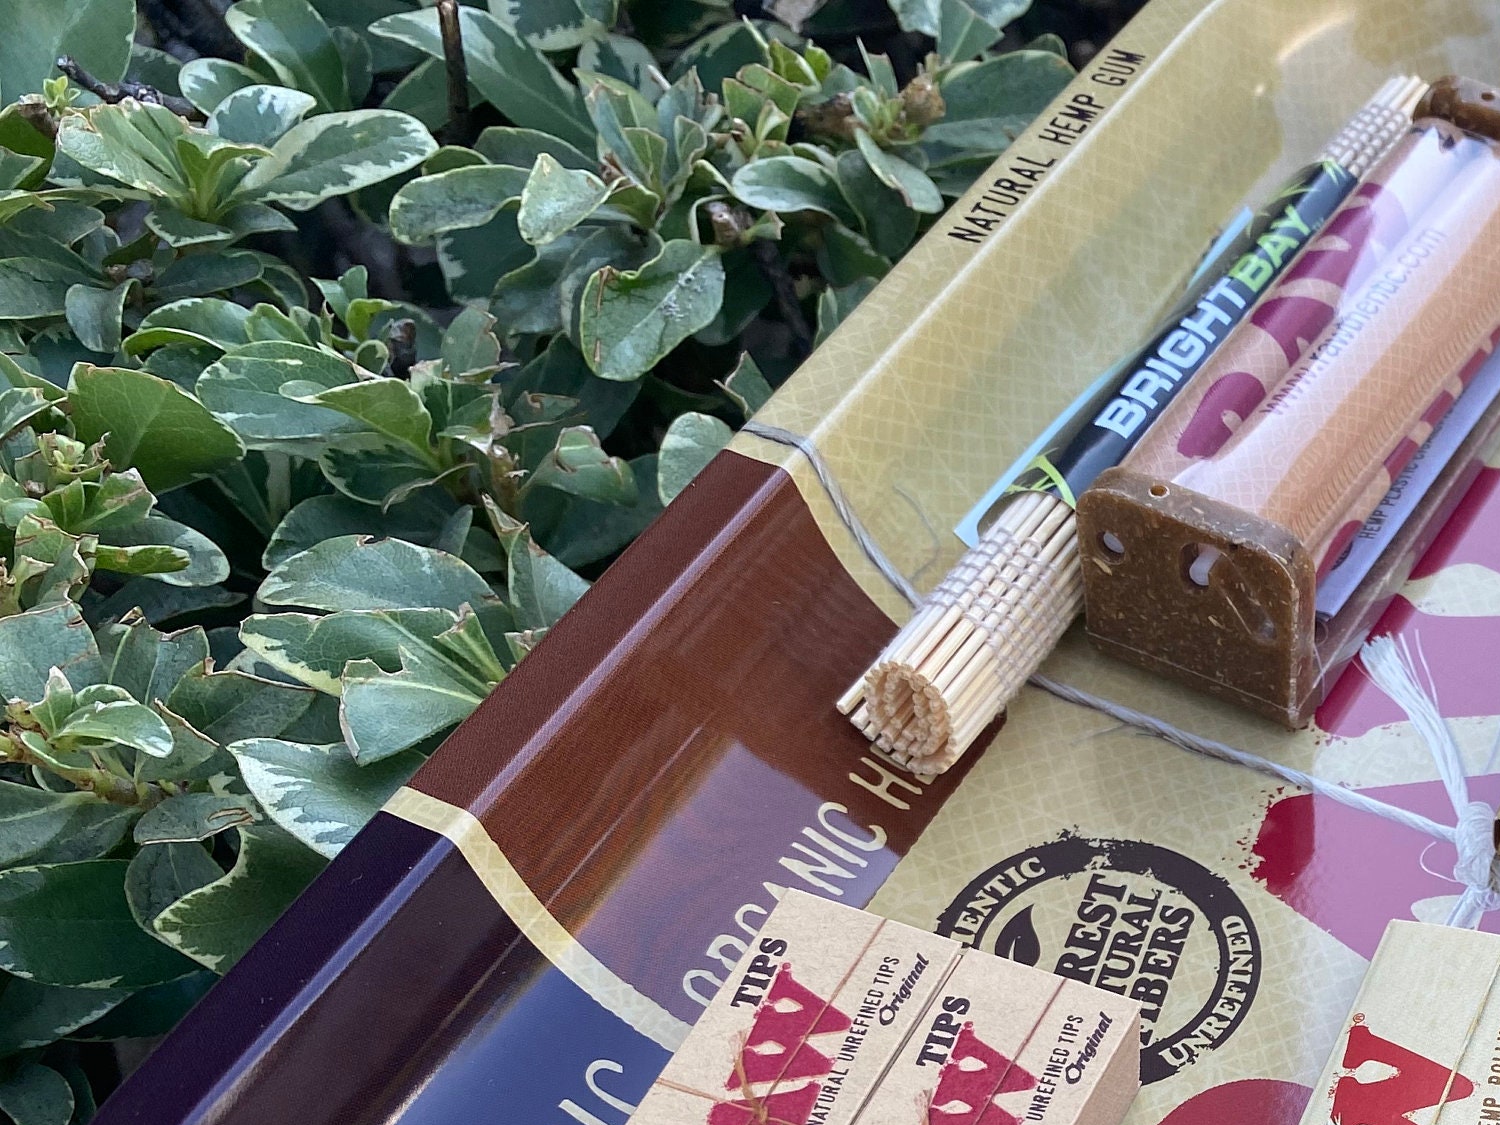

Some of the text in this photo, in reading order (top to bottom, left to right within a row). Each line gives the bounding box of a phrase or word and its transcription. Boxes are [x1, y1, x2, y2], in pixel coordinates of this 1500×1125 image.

[948, 50, 1145, 244] NATURAL HEMP GUM
[1095, 205, 1312, 440] BRIGHTBAY
[1358, 509, 1388, 539] HEMP
[730, 937, 788, 1008] TIPS
[1055, 874, 1127, 982] REST
[837, 988, 884, 1062] UNREFINED
[873, 956, 900, 986] TIPS
[879, 952, 930, 1026] Original
[916, 996, 971, 1067] TIPS
[1159, 914, 1249, 1067] UNREFINED
[1026, 1047, 1070, 1122] UNREFINED
[1058, 1014, 1084, 1044] TIPS
[1065, 1011, 1113, 1085] Original
